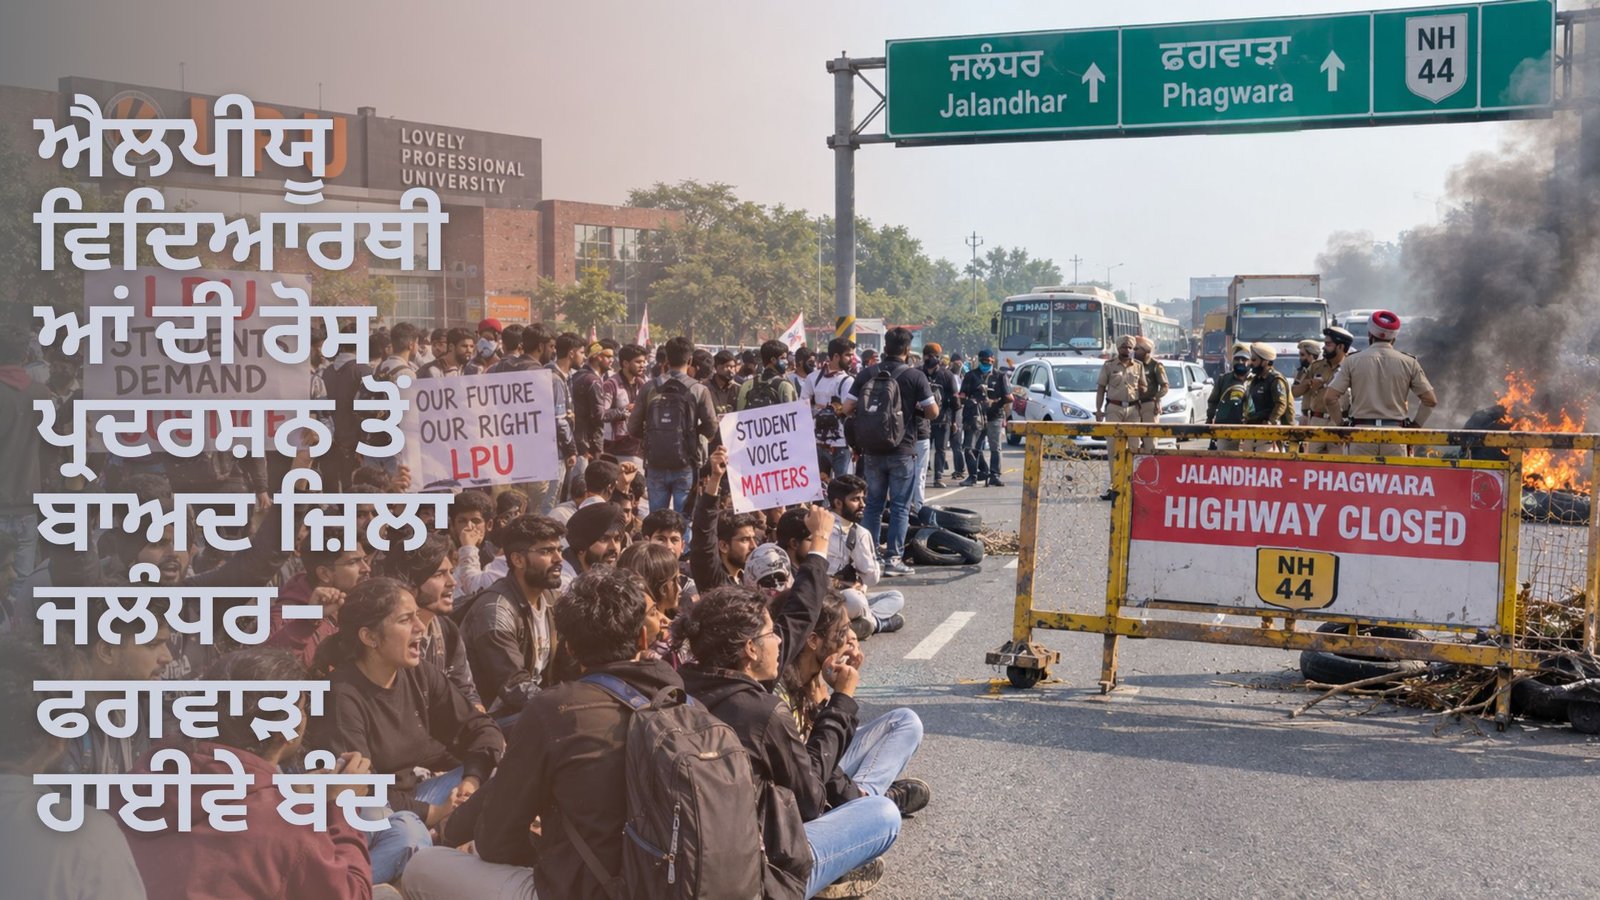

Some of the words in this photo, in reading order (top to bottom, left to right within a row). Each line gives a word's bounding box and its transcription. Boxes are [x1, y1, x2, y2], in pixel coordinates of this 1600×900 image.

[1418, 26, 1455, 51] NH
[949, 43, 1044, 81] ਜਲੰਧਰ
[1417, 57, 1454, 83] 44
[940, 89, 1067, 118] Jalandhar
[1163, 82, 1293, 112] Phagwara
[402, 127, 465, 150] LOVELY
[402, 149, 525, 177] PROFESSIONAL
[402, 168, 506, 194] UNIVERSITY
[114, 364, 267, 395] DEMAND
[416, 388, 458, 412] OUR
[466, 382, 535, 408] FUTURE
[420, 417, 468, 444] OUR
[478, 410, 542, 439] RIGHT
[736, 411, 798, 441] STUDENT
[451, 444, 514, 481] LPU
[746, 441, 789, 467] VOICE
[741, 465, 809, 498] MATTERS
[1176, 464, 1283, 489] JALANDHAR
[1303, 469, 1435, 497] PHAGWARA
[1163, 495, 1326, 537] HIGHWAY
[1338, 505, 1467, 546] CLOSED
[1277, 555, 1315, 577] NH
[1275, 577, 1314, 601] 44
